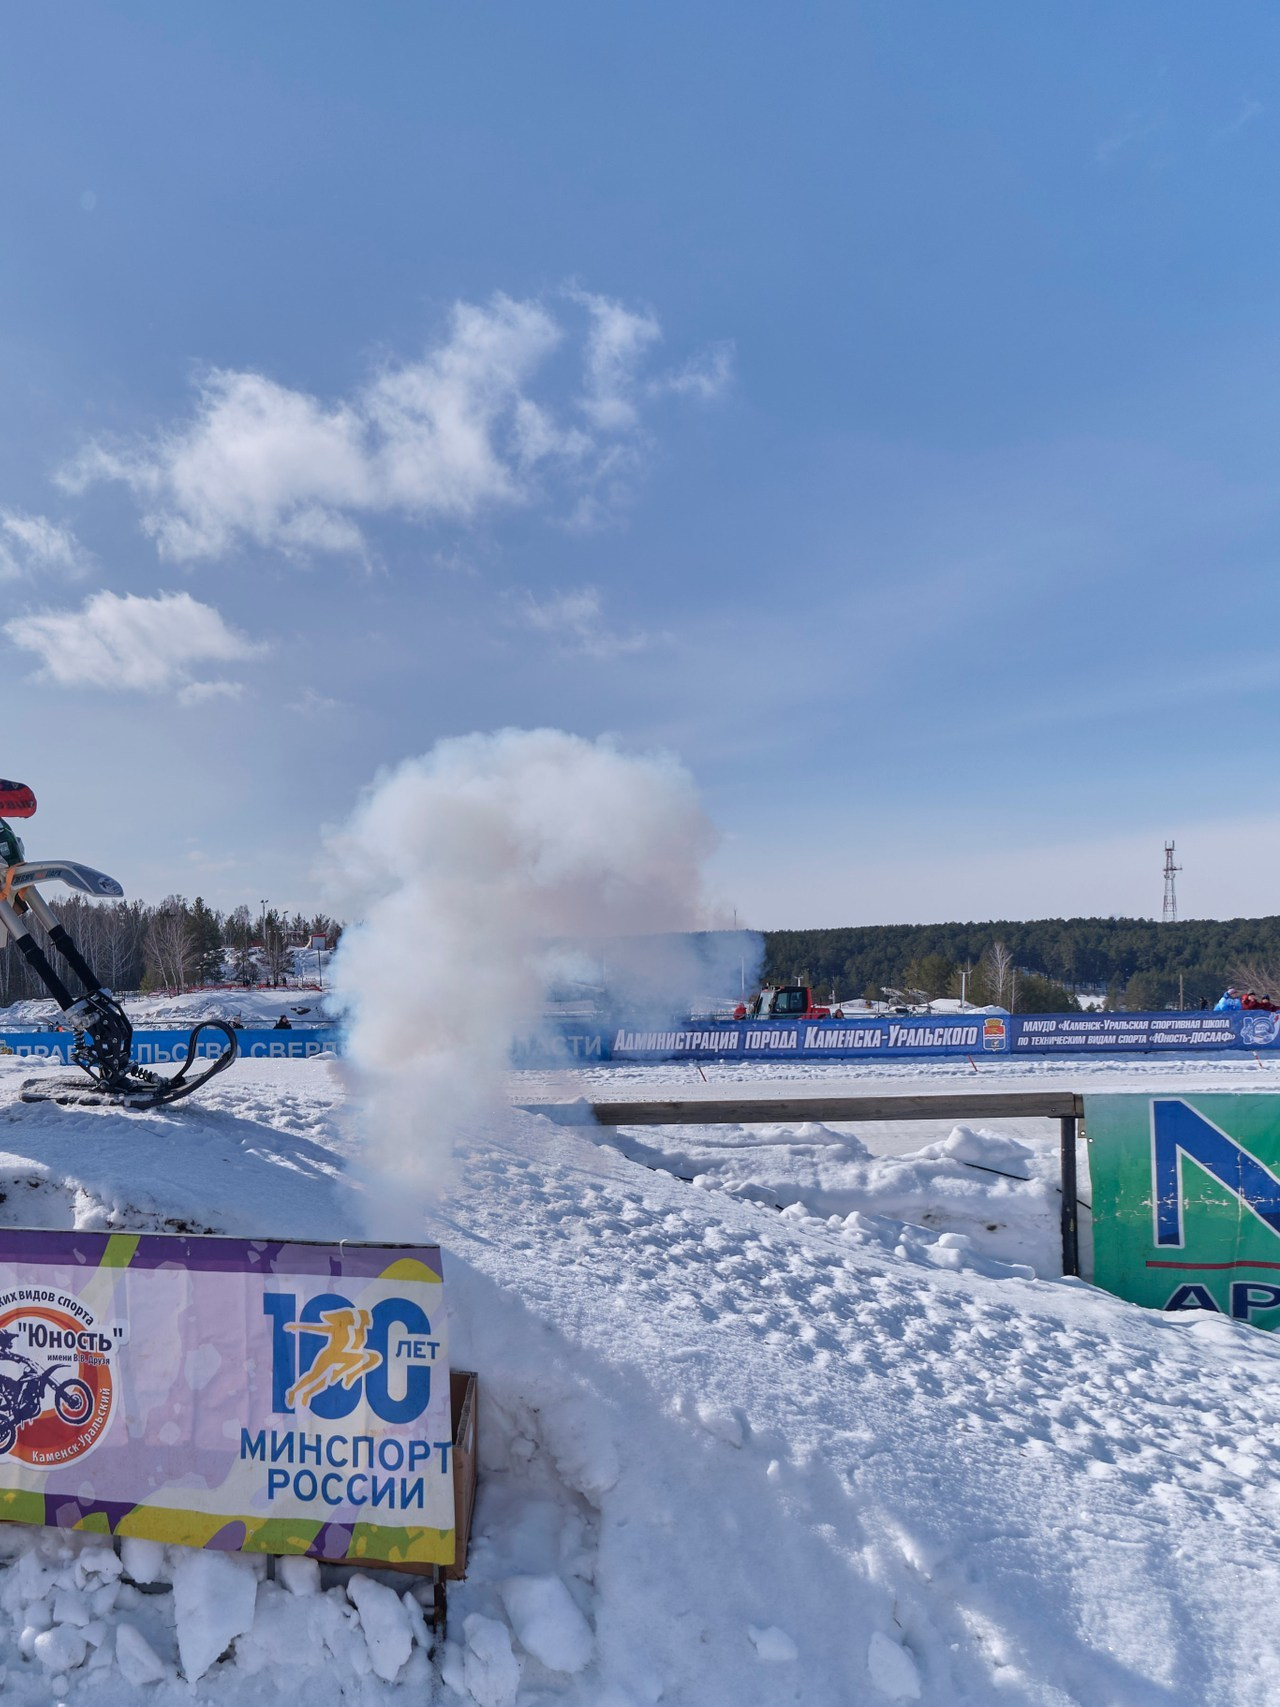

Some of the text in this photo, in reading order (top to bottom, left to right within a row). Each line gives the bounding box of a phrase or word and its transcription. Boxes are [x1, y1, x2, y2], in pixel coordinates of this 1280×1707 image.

[1023, 1020, 1056, 1032] МАУДО
[1202, 1019, 1230, 1029] ШКОЛА
[1017, 1037, 1029, 1046] ПО
[1118, 1034, 1147, 1044] СПОРТА
[57, 1295, 94, 1326] спорта
[47, 1354, 72, 1362] имени
[88, 1355, 110, 1366] Друзя
[263, 1292, 431, 1424] 100
[395, 1340, 440, 1360] ЛЕТ
[240, 1427, 453, 1474] МИНСПОРТ
[268, 1468, 424, 1510] РОССИИ
